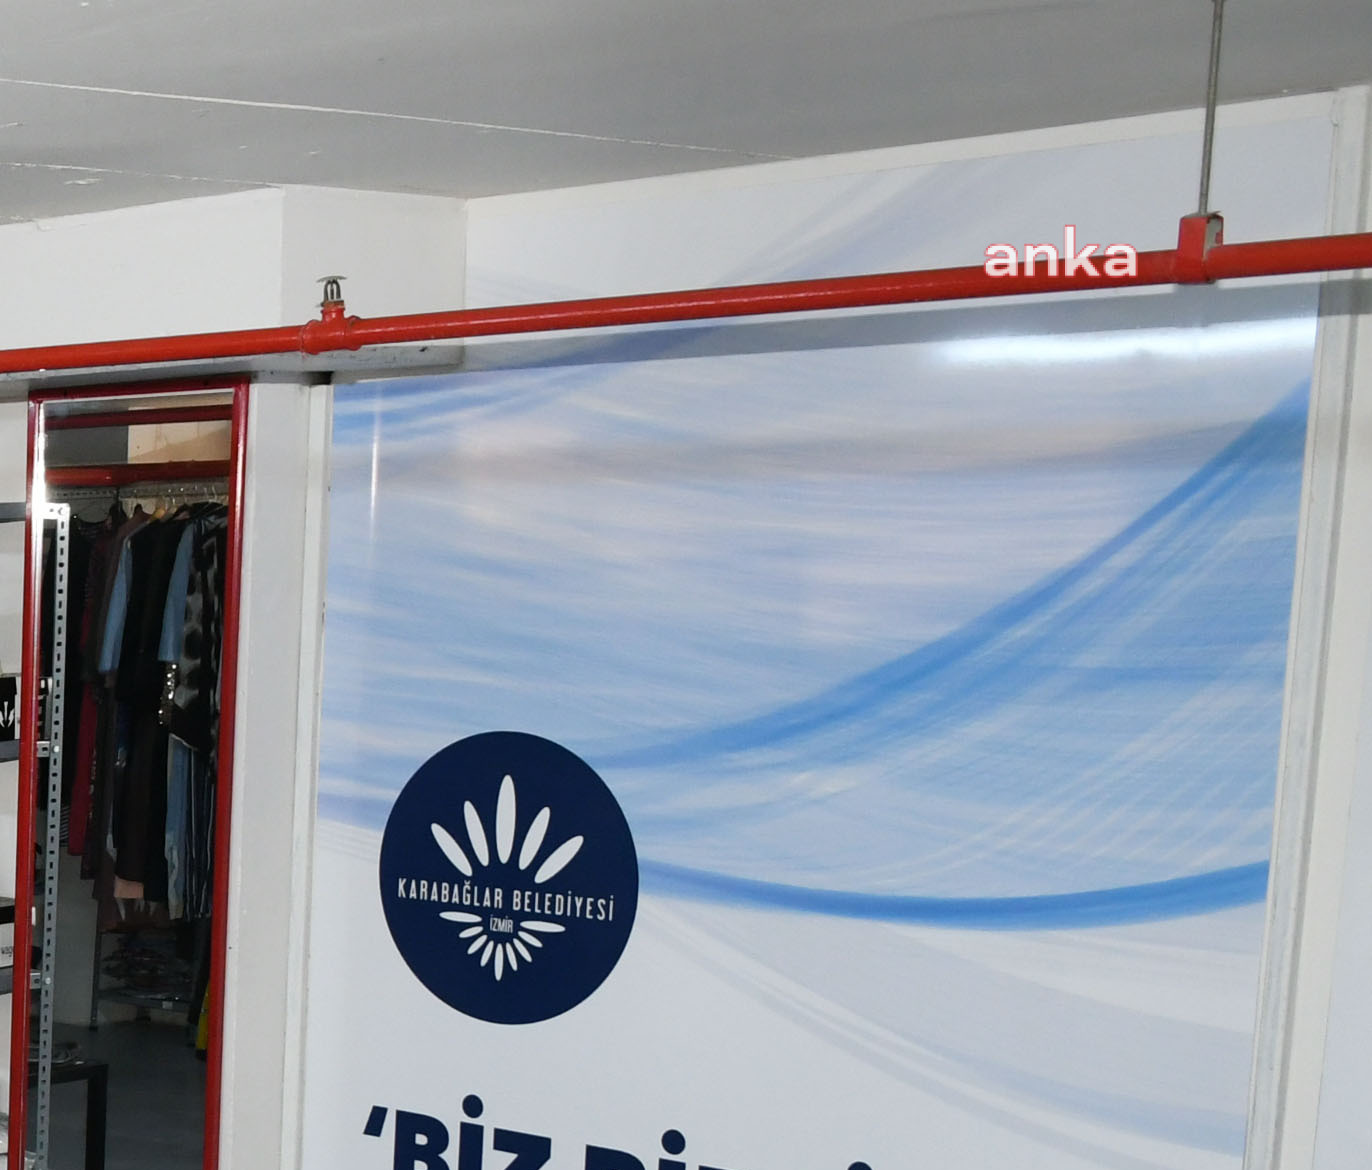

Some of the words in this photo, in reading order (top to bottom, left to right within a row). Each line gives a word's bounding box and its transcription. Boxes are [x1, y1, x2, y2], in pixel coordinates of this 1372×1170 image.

[398, 877, 503, 909] KARABAĞLAR
[512, 890, 615, 922] BELEDİYESİ
[489, 914, 513, 933] İZMİR
